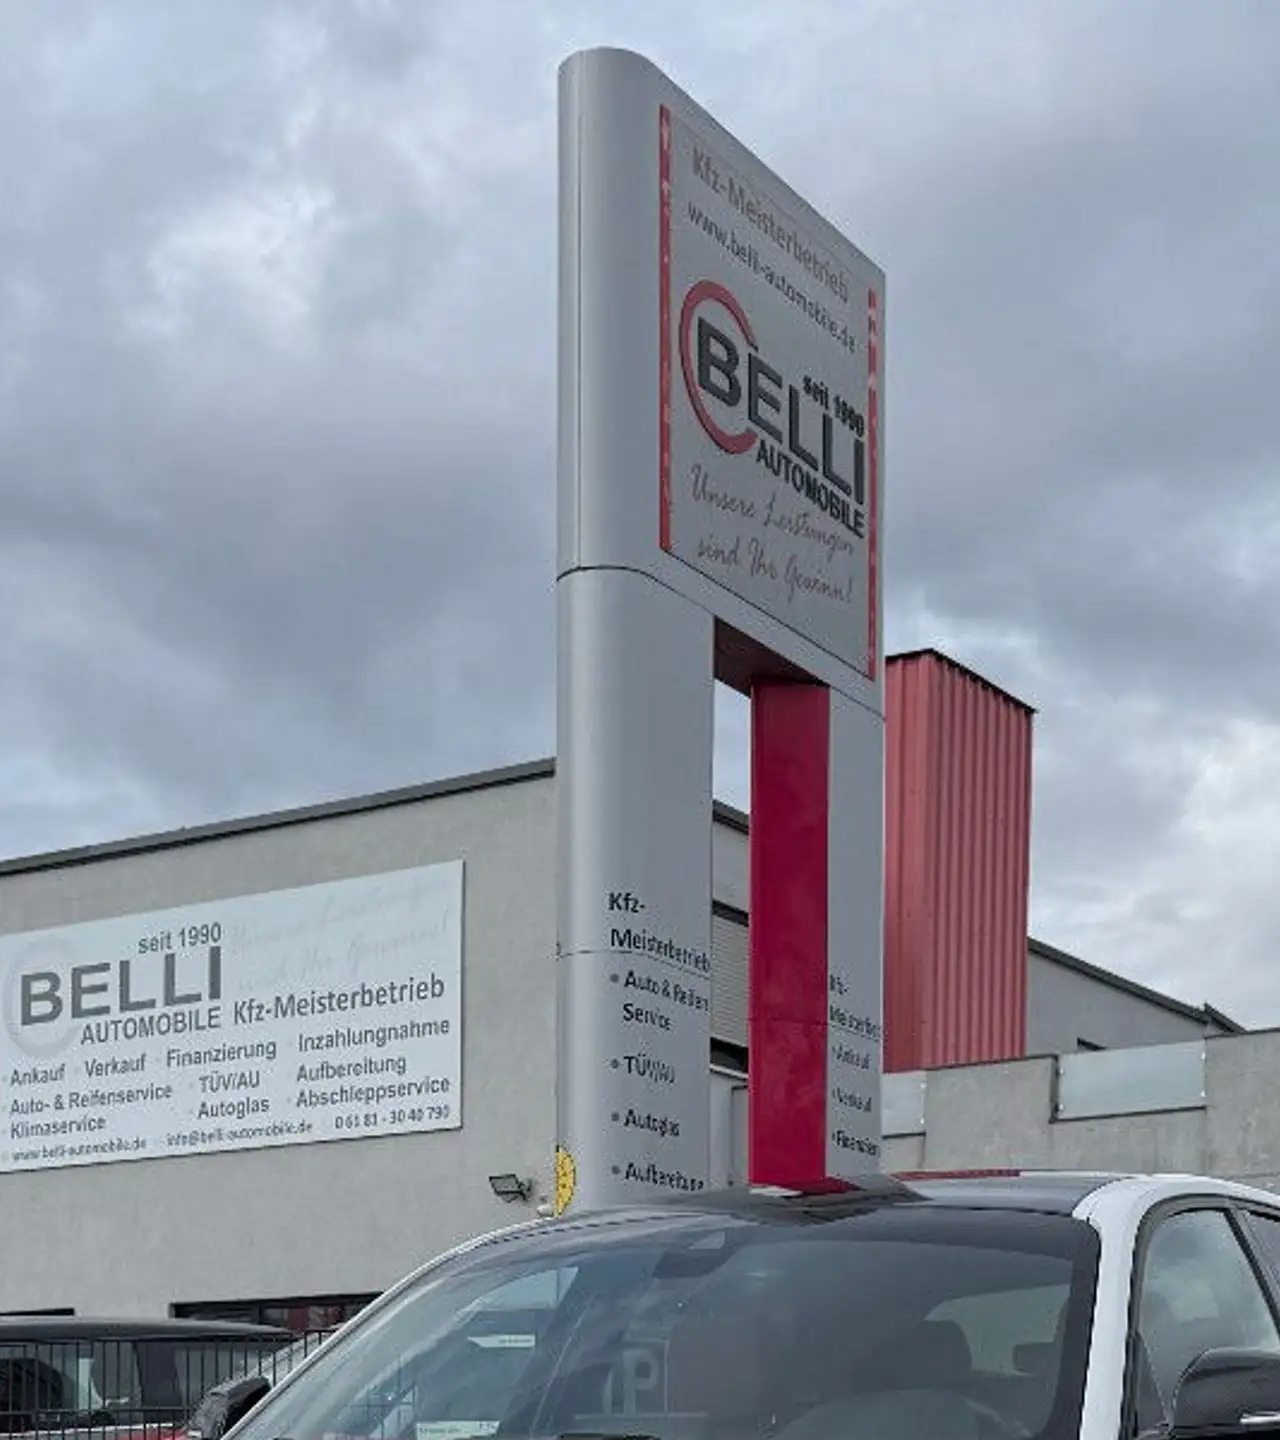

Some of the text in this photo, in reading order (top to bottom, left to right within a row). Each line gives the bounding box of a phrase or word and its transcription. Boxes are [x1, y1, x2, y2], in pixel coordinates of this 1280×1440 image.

[697, 316, 865, 506] BELLI
[756, 439, 865, 540] AUTOMOBILE
[608, 892, 646, 914] Kfz-
[138, 929, 173, 954] seit
[21, 946, 221, 1026] BELLI
[80, 972, 445, 1045] AUTOMOBILE Kfz-Meisterbetrieb
[10, 1018, 450, 1087] Ankauf Verkauf Finanzierung Inzahlungnahme
[54, 1093, 66, 1111] &
[69, 1083, 173, 1109] Reifenservice
[297, 1055, 406, 1083] Aufbereitung
[10, 1075, 450, 1140] Klimaservice Autoglas Abschleppservice
